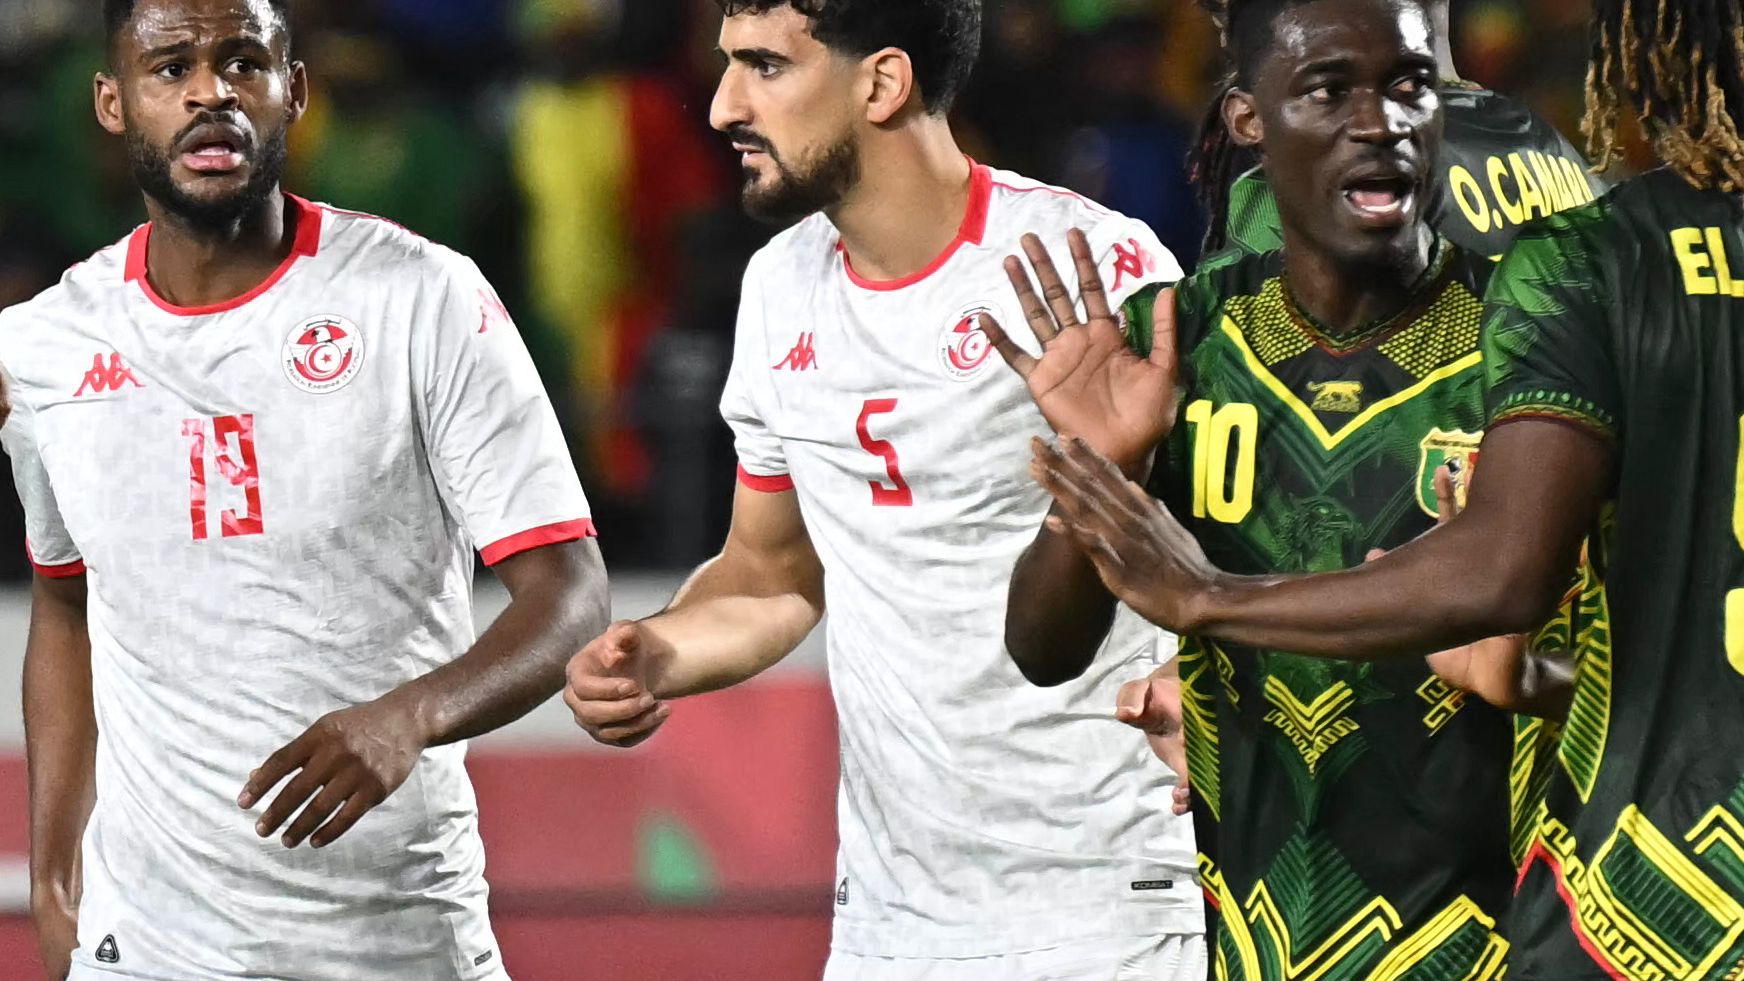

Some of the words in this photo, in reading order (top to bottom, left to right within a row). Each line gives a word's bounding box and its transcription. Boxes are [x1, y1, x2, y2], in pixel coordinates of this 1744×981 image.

[1670, 226, 1744, 298] EL
[182, 413, 265, 541] 19
[855, 398, 913, 507] 5
[1185, 399, 1259, 524] 10
